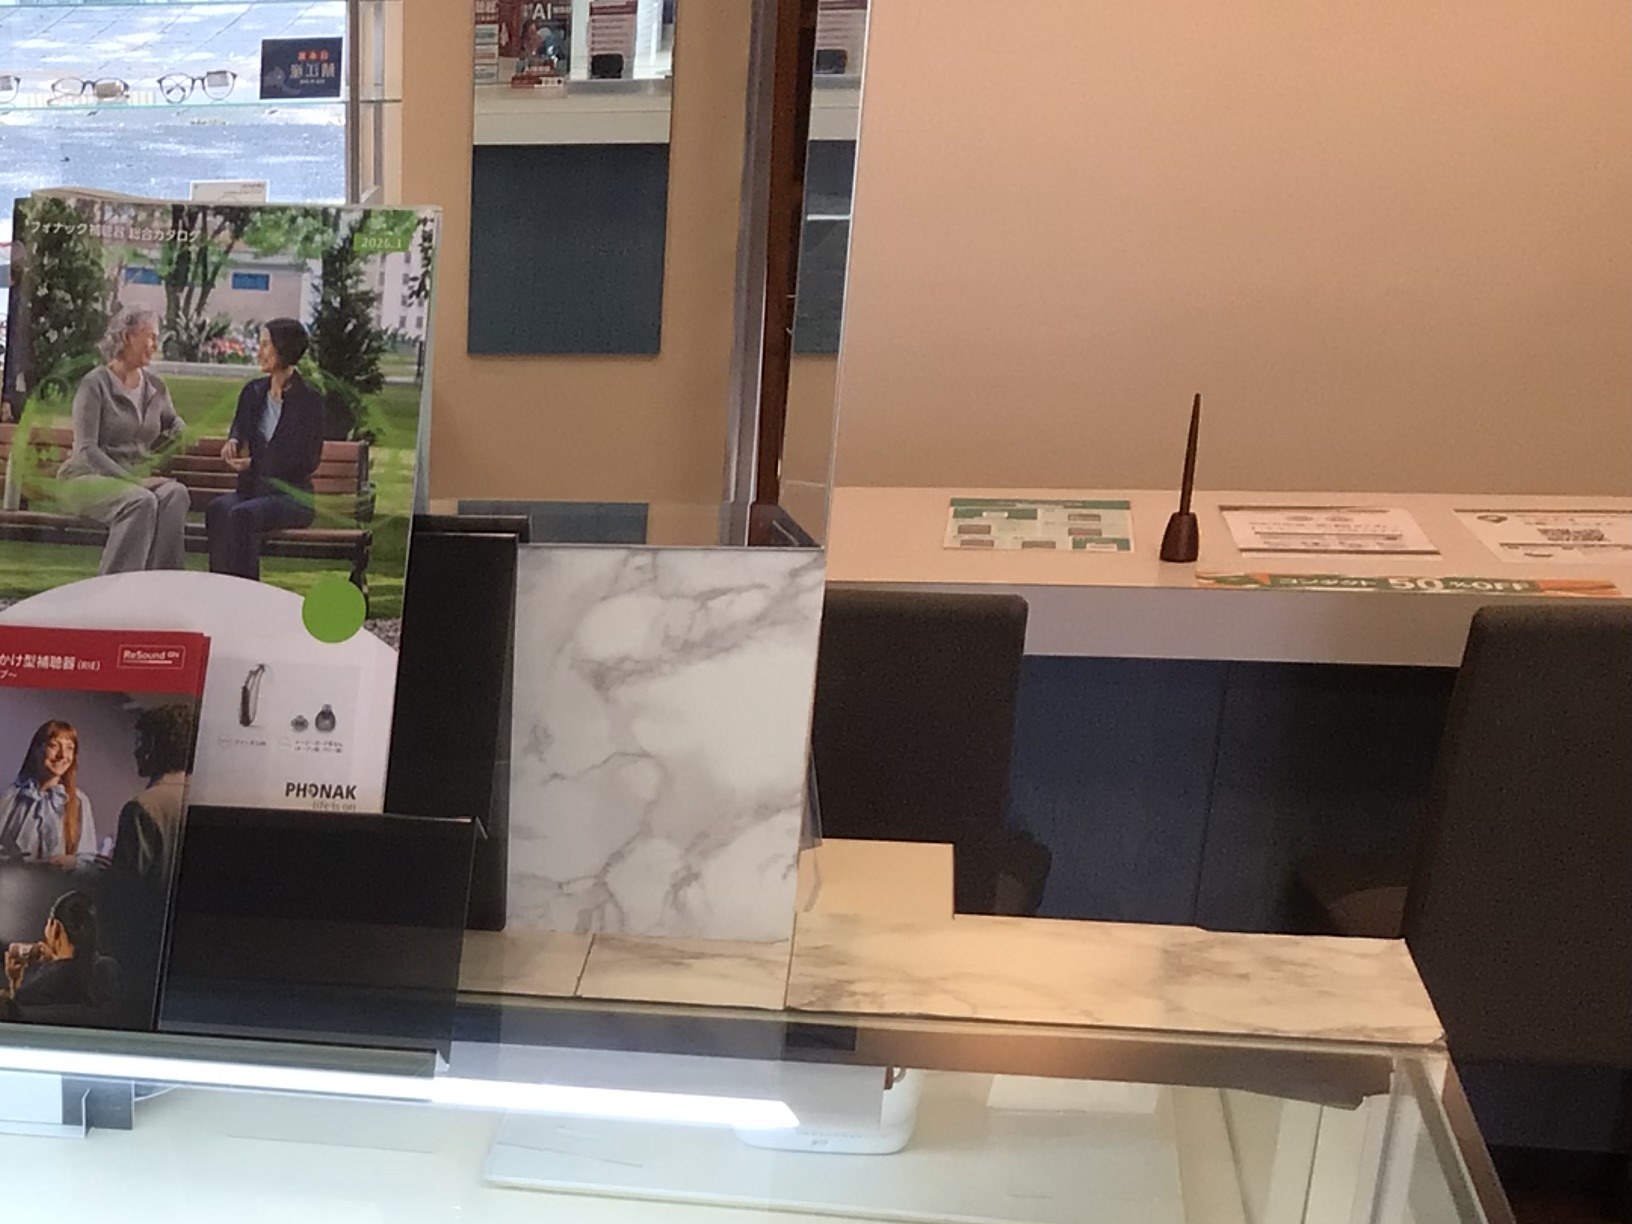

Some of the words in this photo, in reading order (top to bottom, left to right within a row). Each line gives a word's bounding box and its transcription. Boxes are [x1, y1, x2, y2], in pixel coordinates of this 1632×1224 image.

[128, 226, 200, 242] 総合カタログ
[123, 650, 165, 660] ReSound
[285, 782, 357, 799] PHONAK
